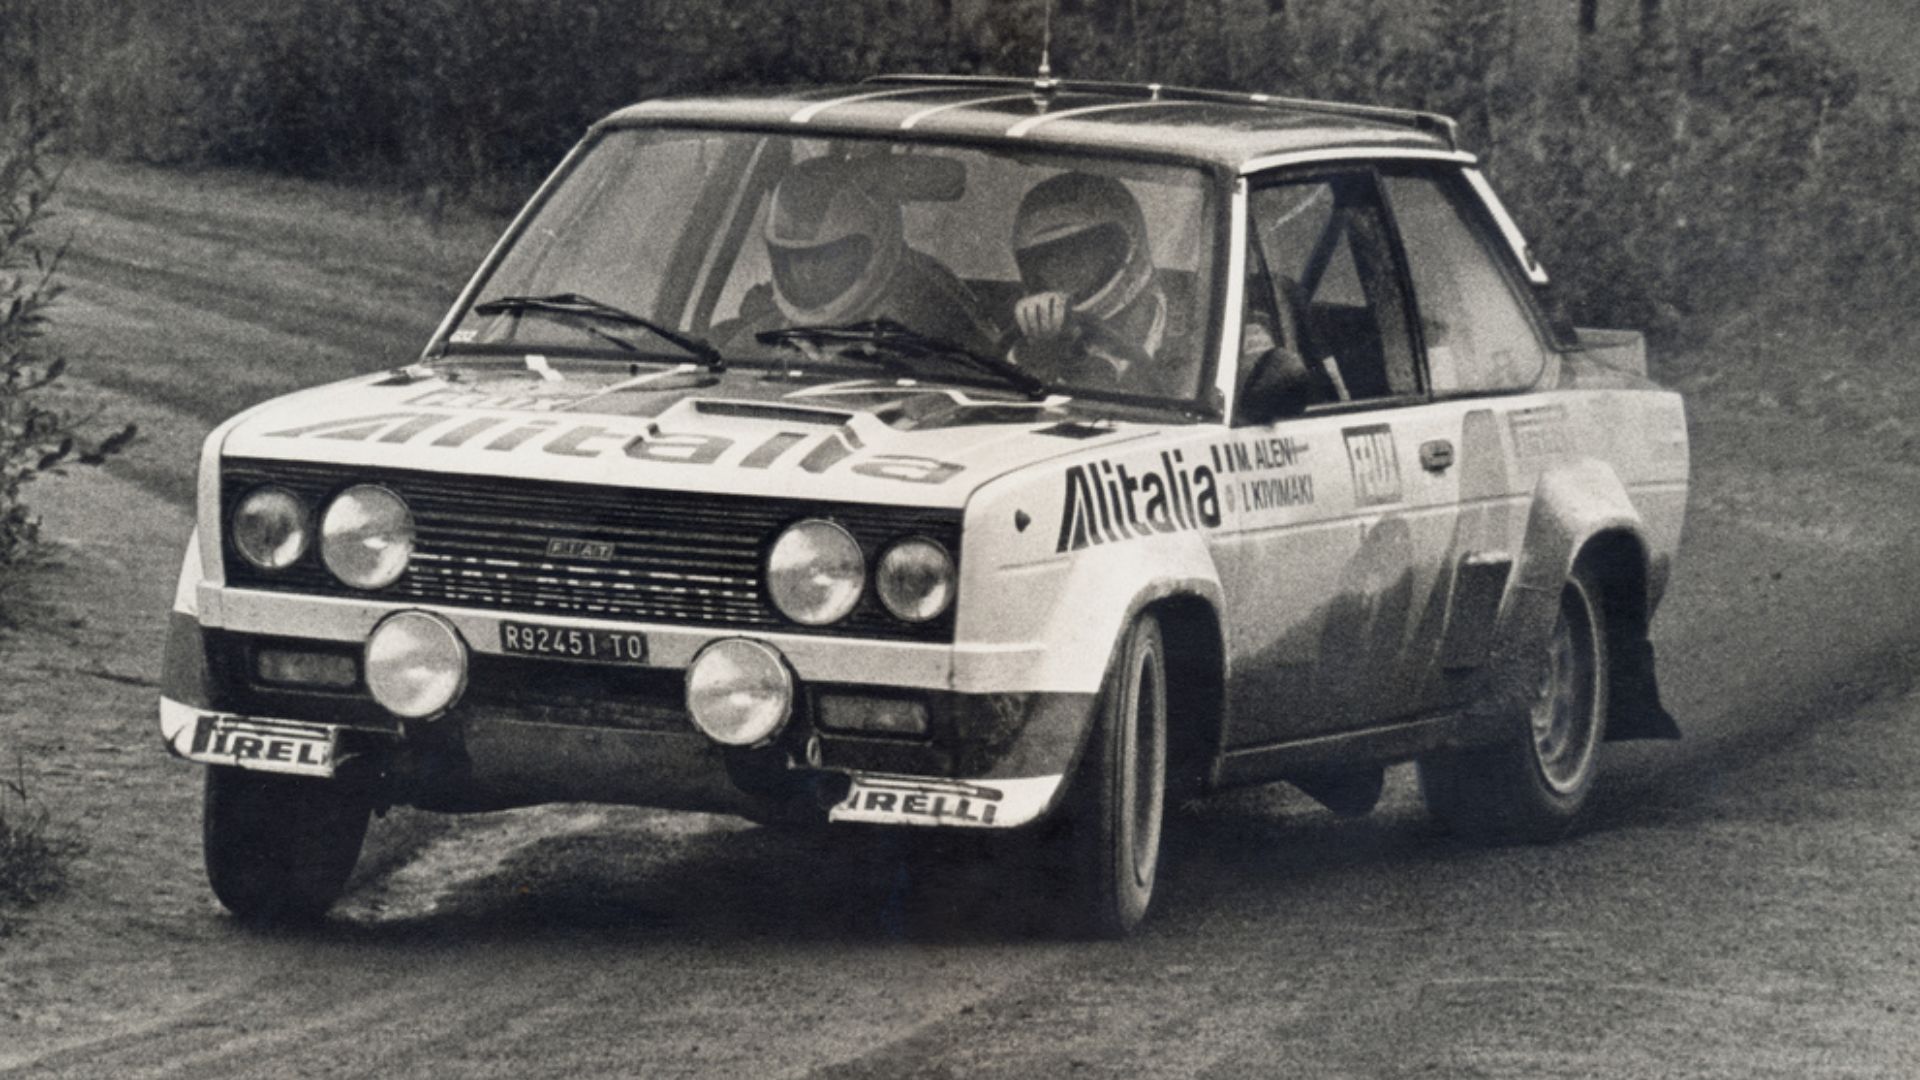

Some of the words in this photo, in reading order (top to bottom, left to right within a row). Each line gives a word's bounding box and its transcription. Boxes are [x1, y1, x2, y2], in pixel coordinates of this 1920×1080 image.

[264, 411, 967, 486] Alitalia
[1056, 448, 1221, 553] Alitalia
[552, 542, 609, 557] FIAT
[505, 626, 596, 656] R92451
